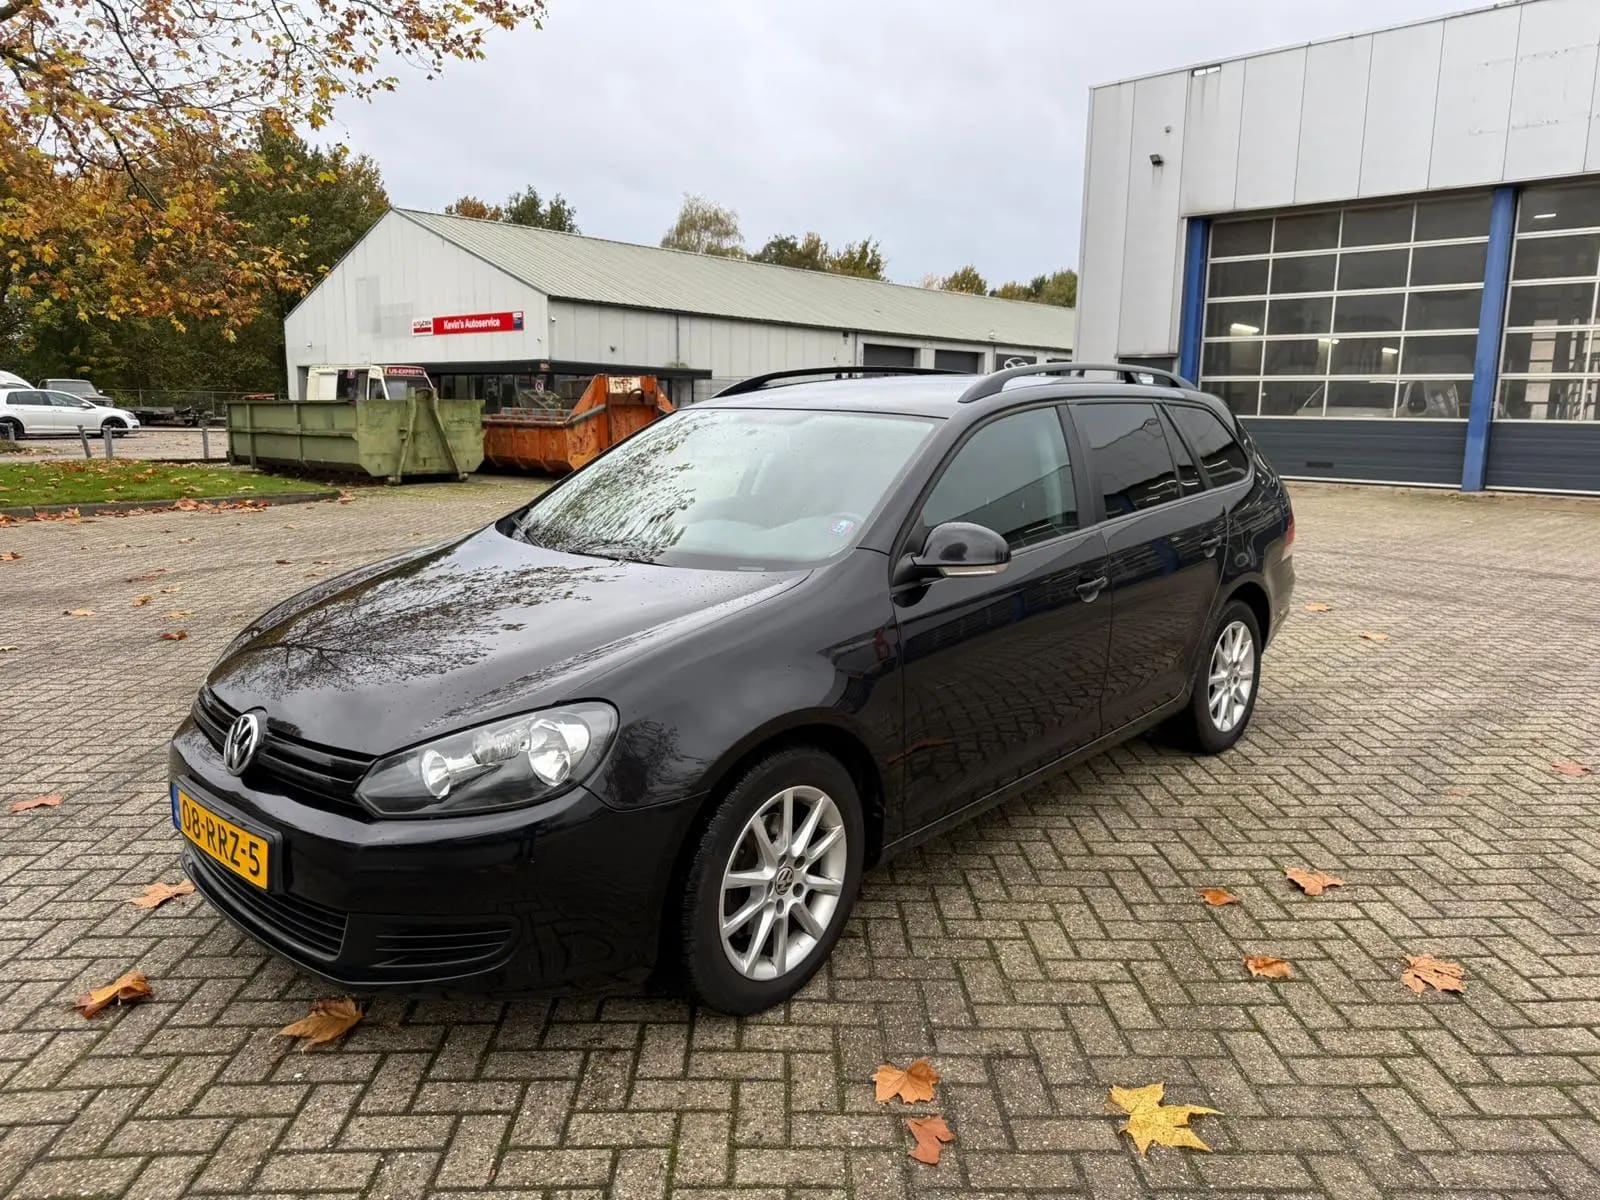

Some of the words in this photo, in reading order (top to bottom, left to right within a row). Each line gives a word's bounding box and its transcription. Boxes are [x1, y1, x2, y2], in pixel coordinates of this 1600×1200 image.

[443, 319, 464, 330] Kevin's
[464, 316, 501, 329] Autoservice
[182, 799, 260, 877] 08-RRZ-5
